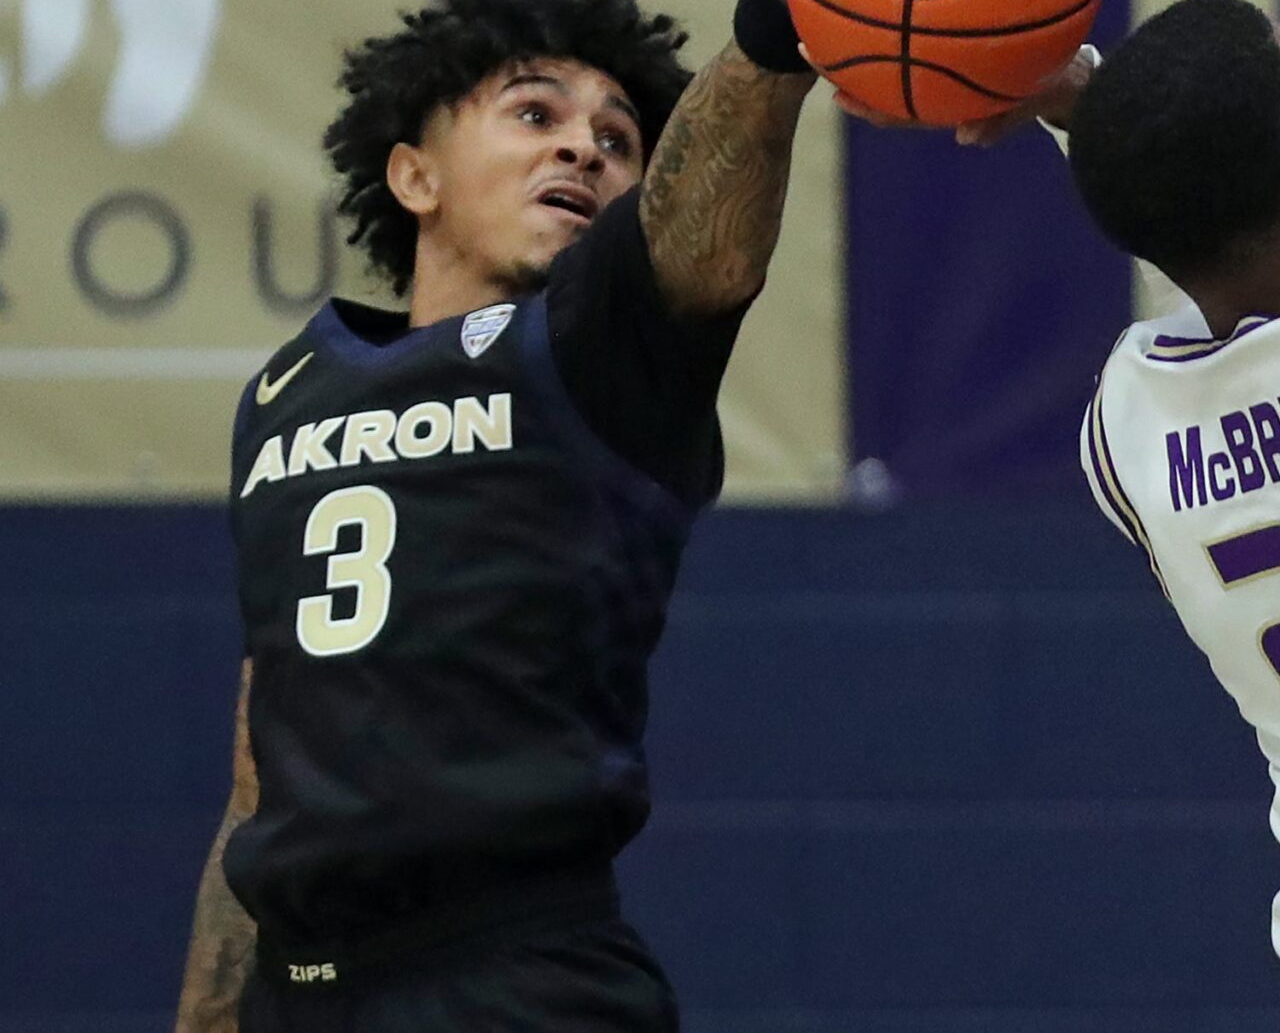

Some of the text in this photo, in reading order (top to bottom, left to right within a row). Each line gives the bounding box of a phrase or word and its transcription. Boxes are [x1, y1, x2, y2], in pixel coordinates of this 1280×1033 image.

[240, 392, 513, 498] AKRON
[296, 485, 397, 657] 3
[288, 962, 337, 983] ZIPS
